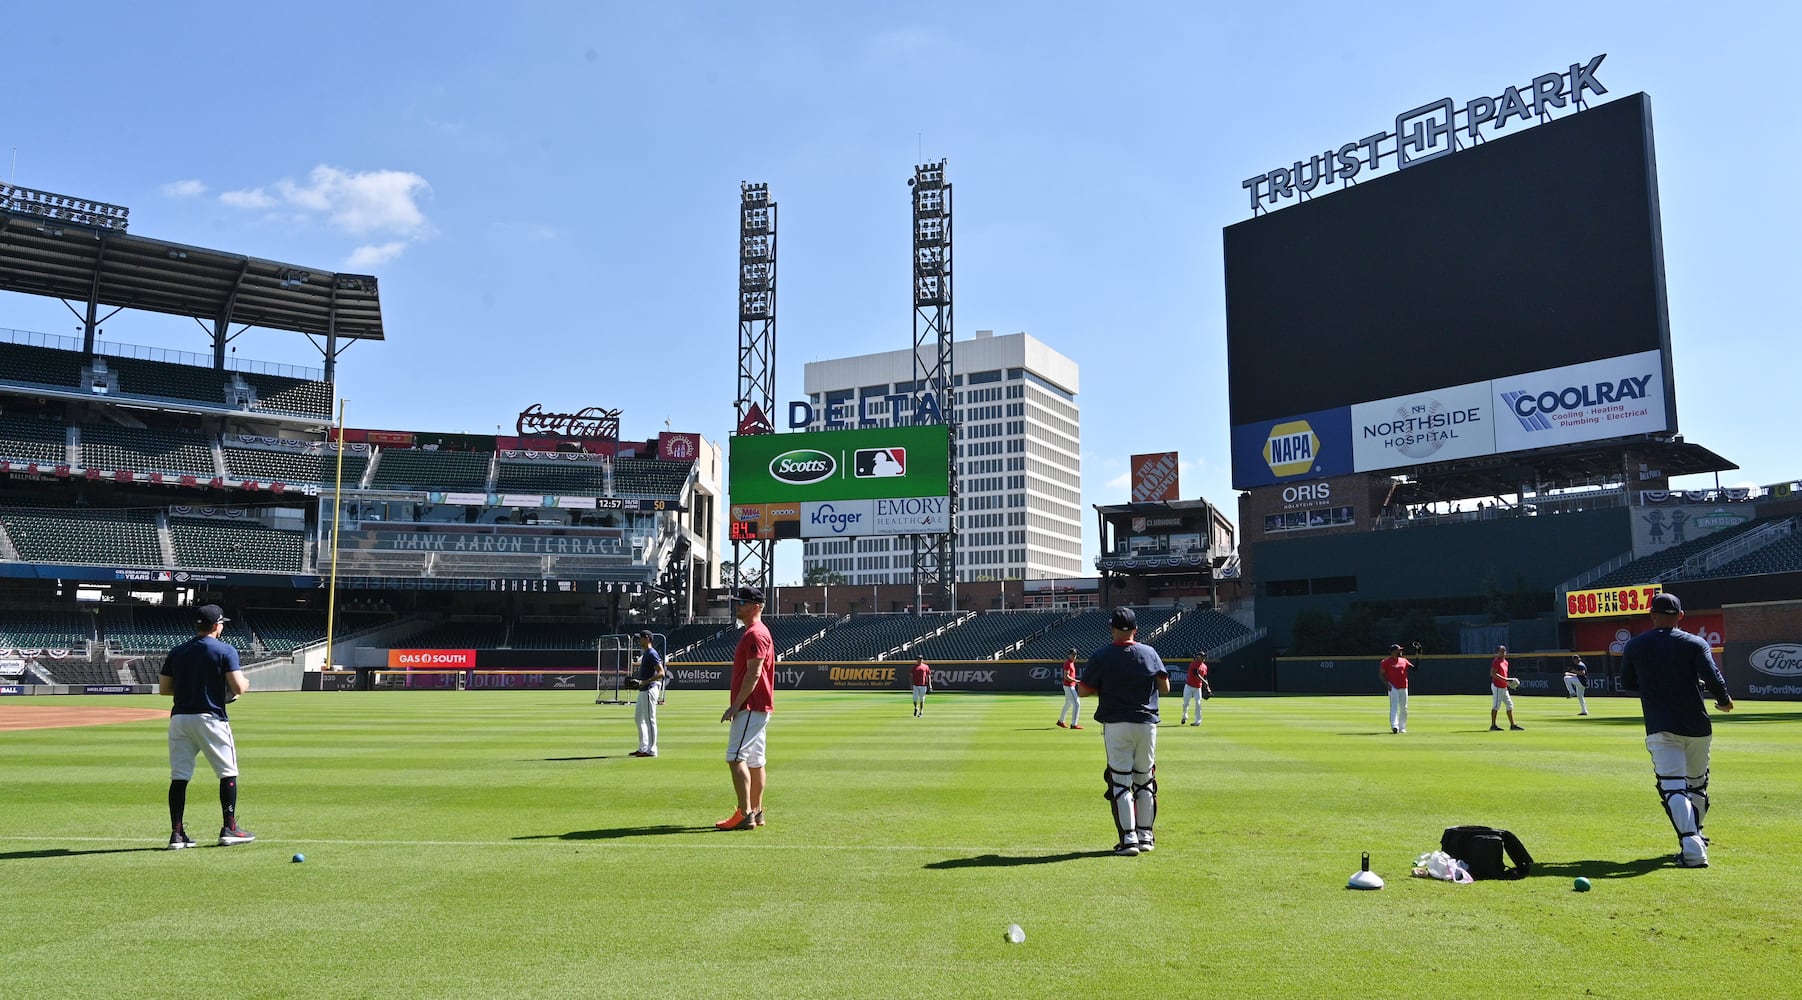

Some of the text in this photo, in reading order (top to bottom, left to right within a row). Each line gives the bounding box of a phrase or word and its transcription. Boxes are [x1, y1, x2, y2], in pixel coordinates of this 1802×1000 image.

[1242, 53, 1608, 210] TRUIST PARK
[1515, 374, 1652, 417] COOLRAY
[789, 392, 945, 429] DELTA
[1552, 404, 1624, 421] Cooling Heating
[1560, 409, 1648, 427] Plumbing Electrical
[1364, 407, 1481, 438] NORTHSIDE
[1384, 430, 1458, 448] HOSPITAL
[1272, 434, 1311, 463] NAPA
[779, 459, 826, 473] Scotts
[1136, 459, 1155, 478] THE
[1132, 454, 1178, 502] HOME
[1151, 470, 1178, 501] DEPOT
[301, 484, 317, 496] 42
[1282, 483, 1330, 502] ORIS
[599, 500, 621, 509] 12:57
[877, 498, 945, 516] EMORY
[732, 521, 749, 534] 84
[811, 504, 862, 533] Kroger
[395, 534, 621, 554] HANK AARON TERRACE
[490, 580, 538, 591] R H E
[1568, 593, 1597, 614] 680
[1597, 591, 1618, 602] THE
[1618, 588, 1655, 611] 93.7
[1598, 601, 1618, 613] FAN
[400, 654, 467, 663] GAS SOUTH
[1319, 661, 1334, 669] 400
[677, 669, 722, 679] Wellstar
[830, 667, 897, 681] QUIKRETE
